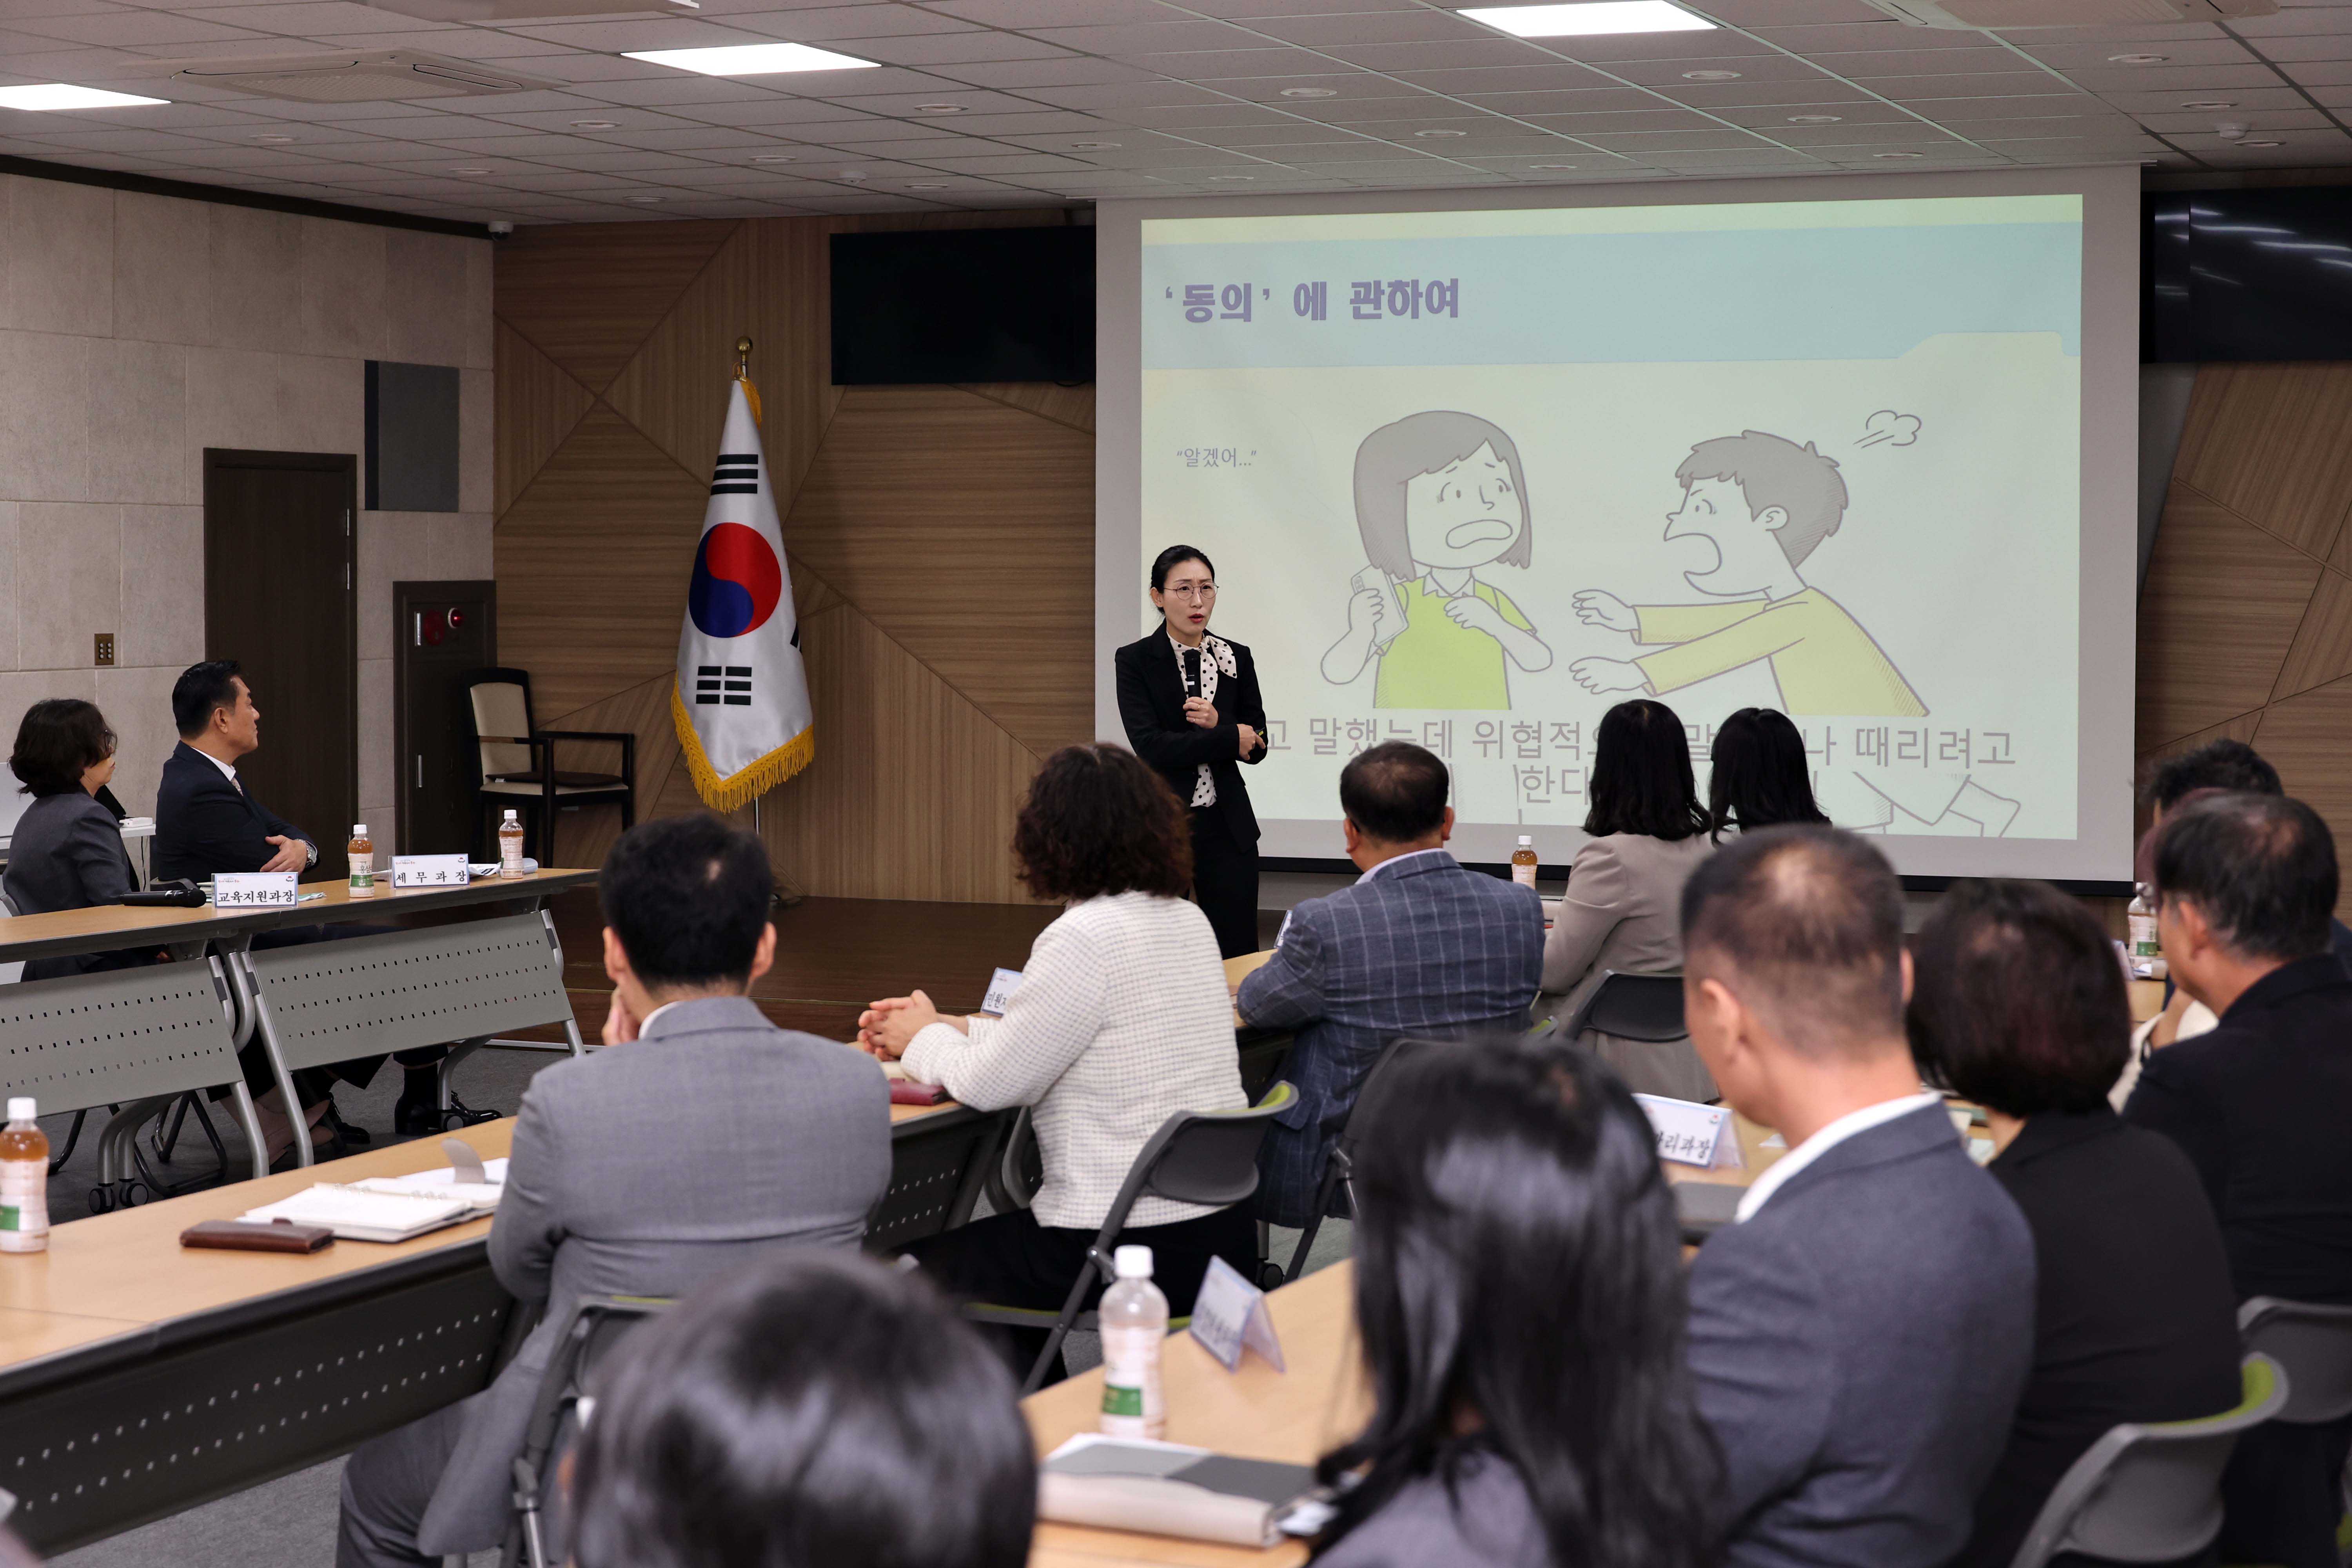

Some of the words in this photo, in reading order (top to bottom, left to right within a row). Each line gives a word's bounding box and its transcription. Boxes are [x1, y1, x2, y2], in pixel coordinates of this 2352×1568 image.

[1294, 281, 1327, 320] 에
[1350, 278, 1458, 319] 관하여
[1856, 728, 2016, 769] 때리려고
[218, 890, 294, 903] 교육지원과장
